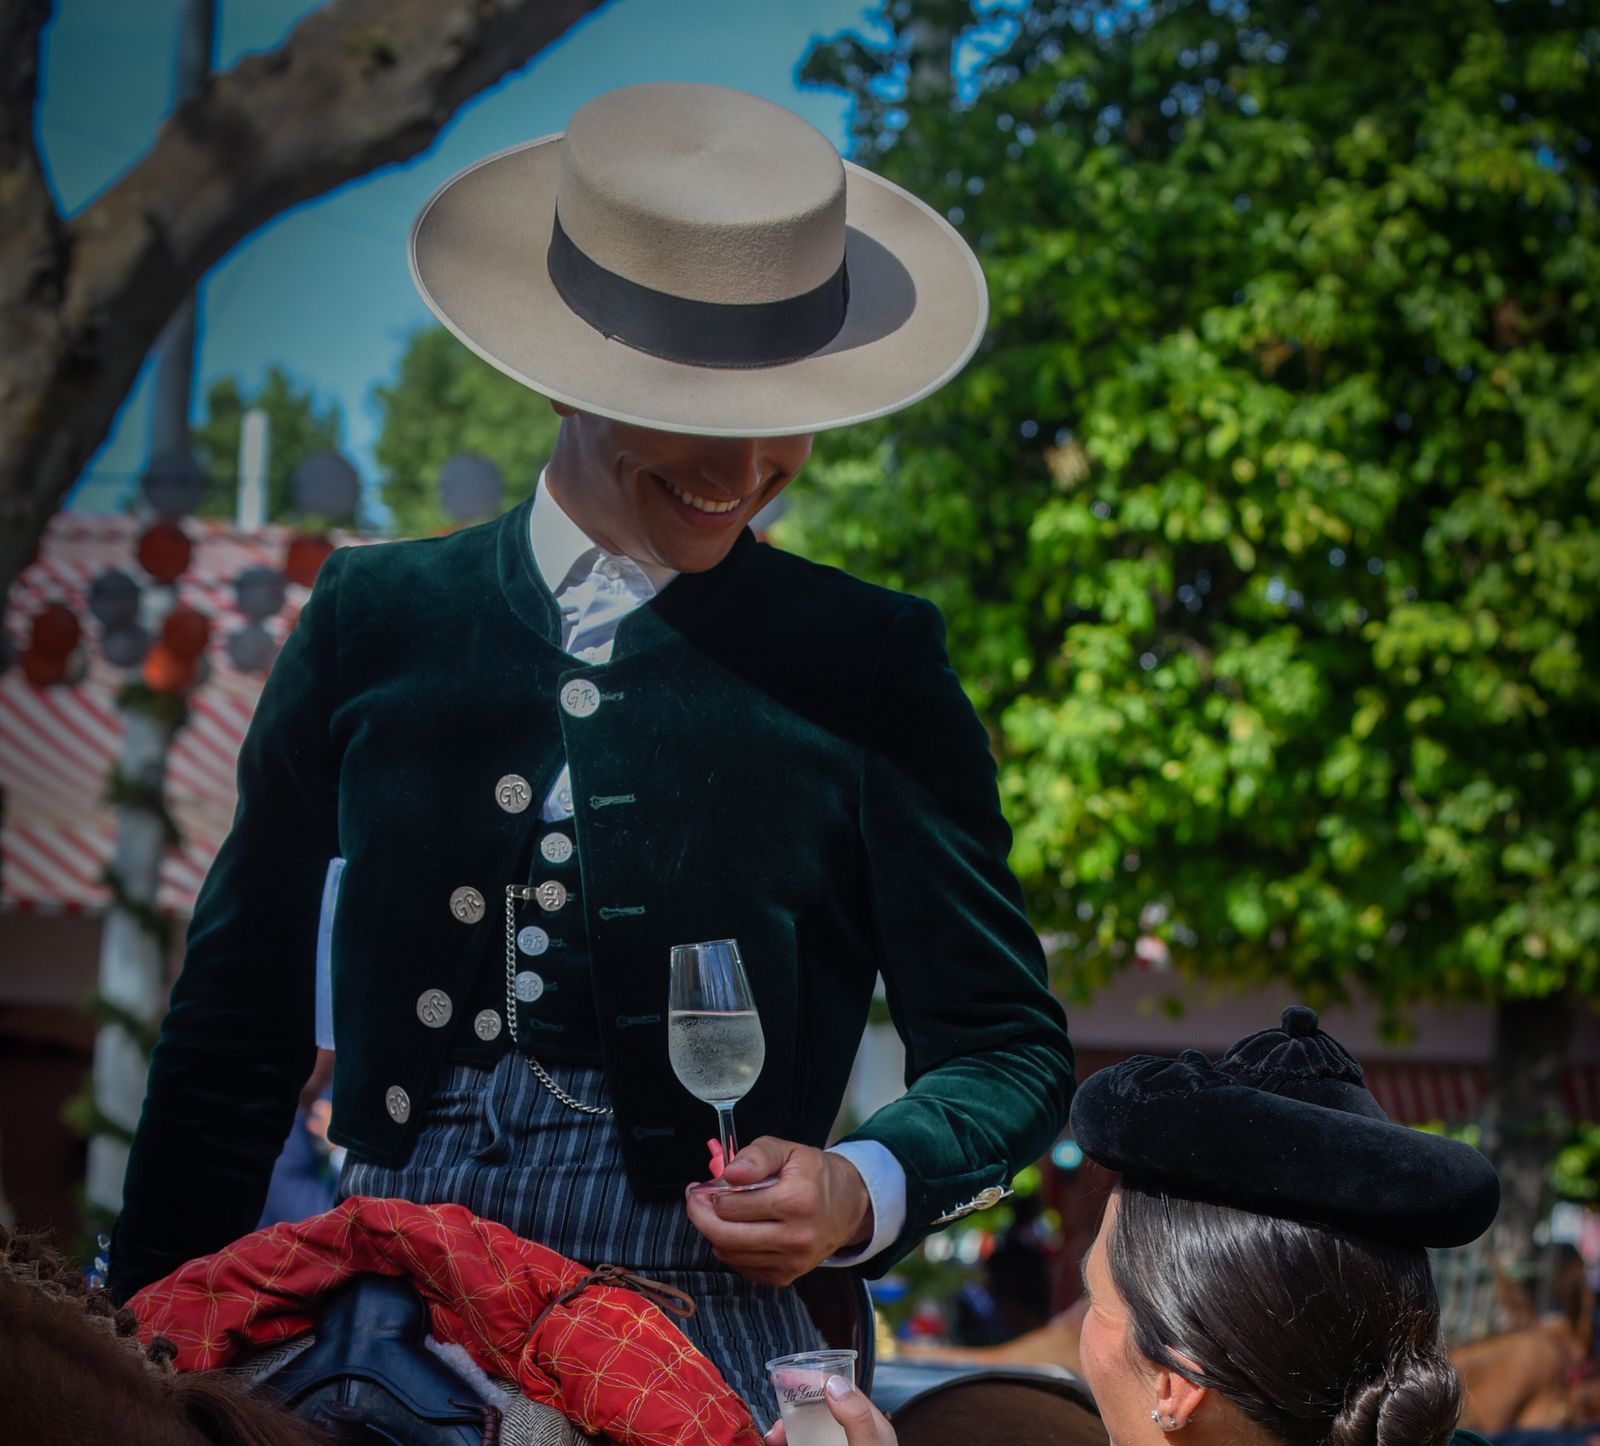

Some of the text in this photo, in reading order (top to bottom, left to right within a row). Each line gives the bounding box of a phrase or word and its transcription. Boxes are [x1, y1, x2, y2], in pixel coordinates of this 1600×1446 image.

[566, 688, 596, 709] GR
[499, 782, 528, 807] GR
[547, 840, 568, 858] GR
[454, 892, 481, 919] GR
[543, 885, 560, 908] GR
[421, 993, 447, 1023] GR
[477, 1017, 498, 1035] GR
[389, 1094, 408, 1116] GR
